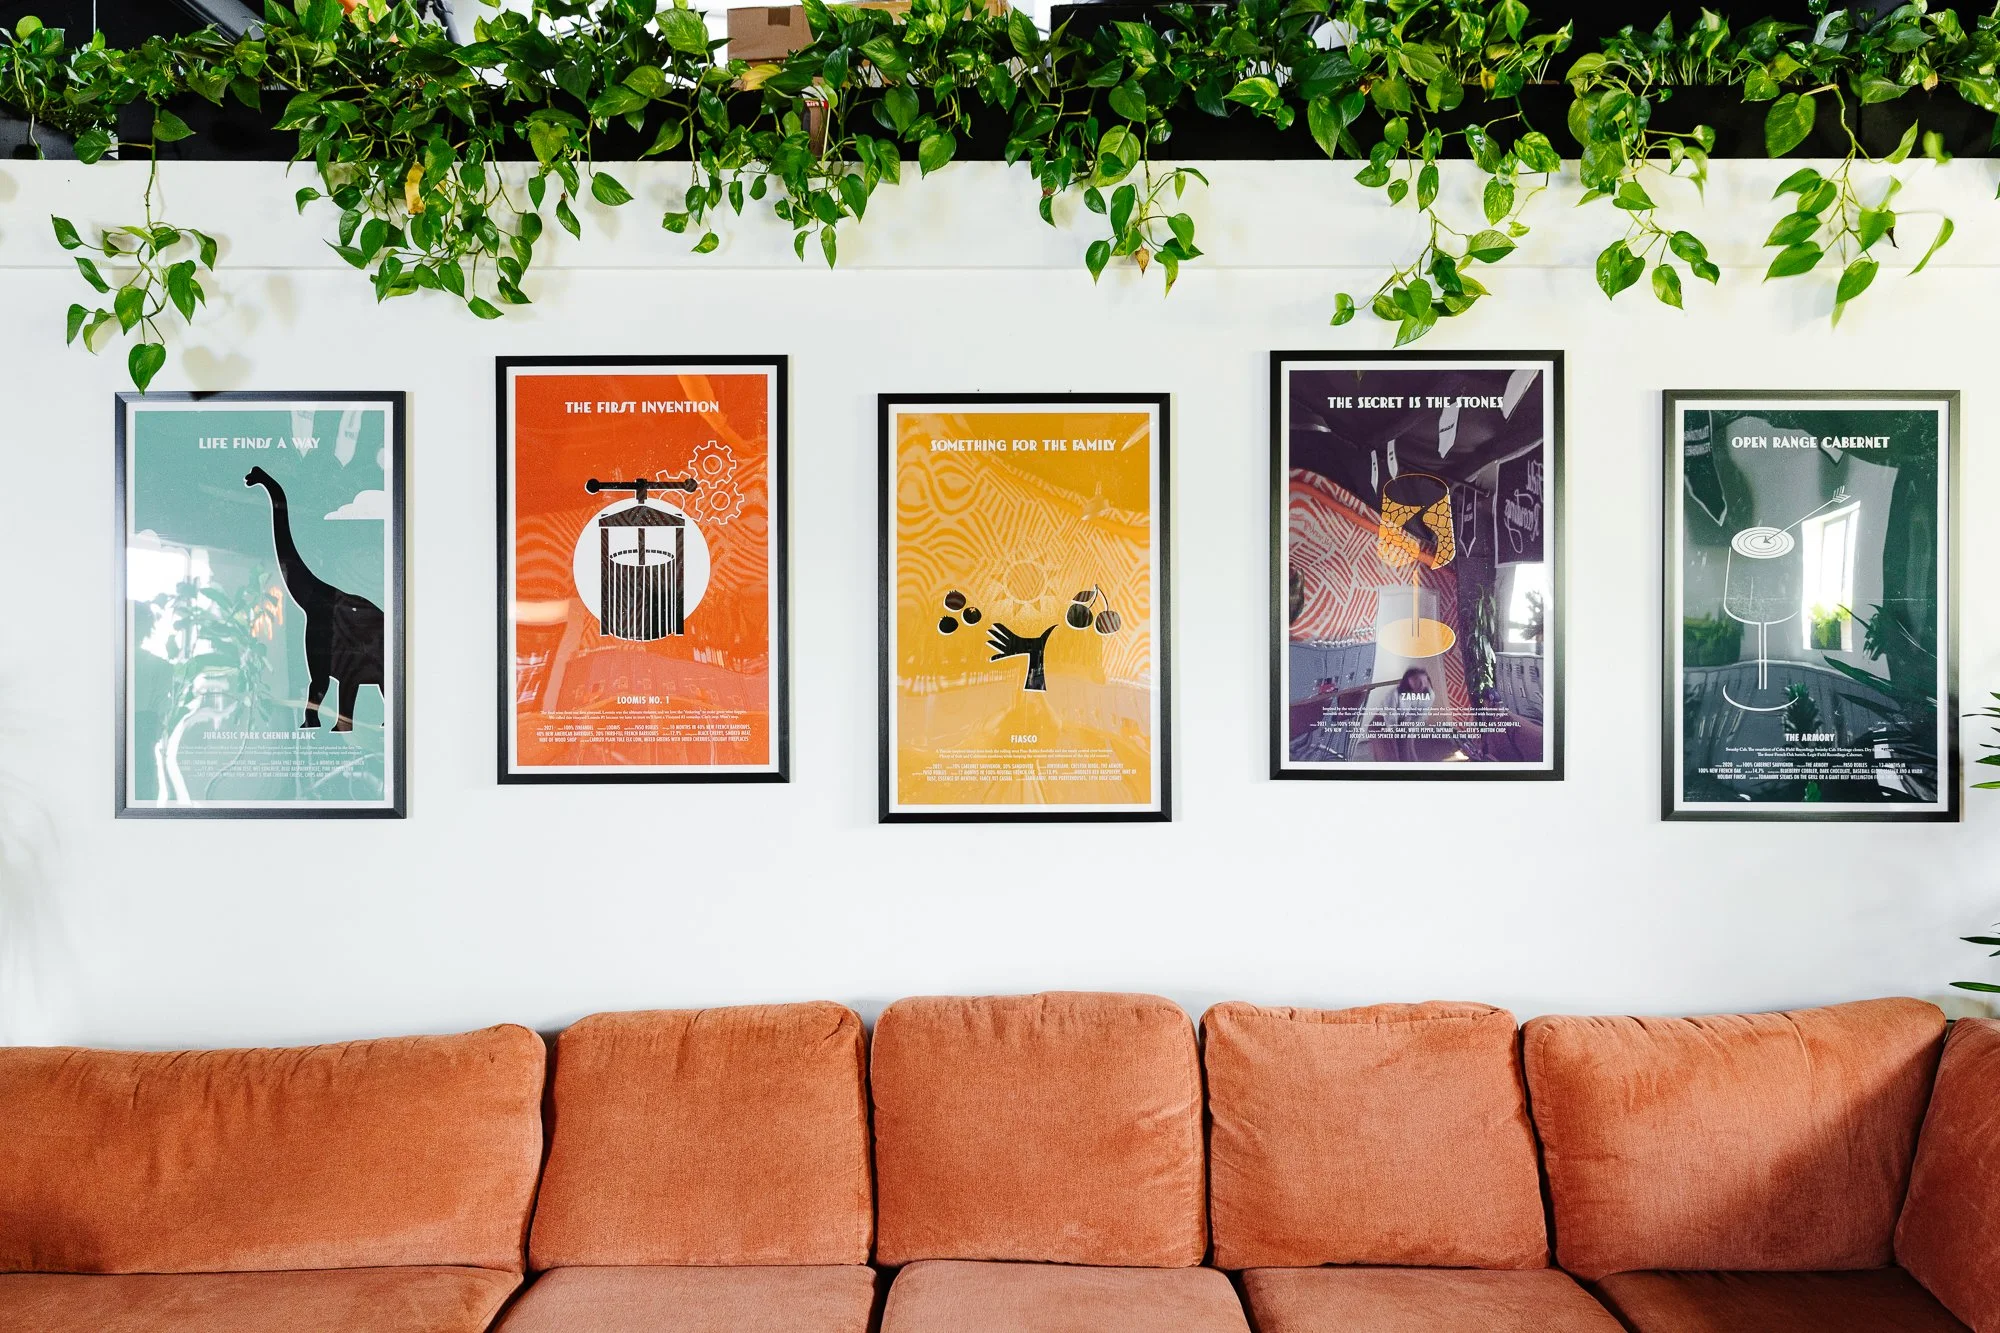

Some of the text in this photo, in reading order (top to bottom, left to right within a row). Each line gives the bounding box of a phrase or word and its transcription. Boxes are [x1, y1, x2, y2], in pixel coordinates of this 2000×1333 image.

[565, 400, 720, 414] THE FIRST INVENTION
[1328, 396, 1504, 409] THE SECRET IS THE STONES
[199, 437, 320, 449] LIFE FINDS A WAY
[930, 440, 1117, 452] SOMETHING FOR THE FAMILY
[1732, 436, 1890, 449] OPEN RANGE CABERNET
[617, 696, 670, 705] LOOMIS NO. 1
[1401, 693, 1431, 701] ZABALA
[203, 732, 316, 740] JURASSIC PARK CHENIN BLANC
[1011, 735, 1037, 744] FIASCO
[1785, 734, 1835, 742] THE ARMORY
